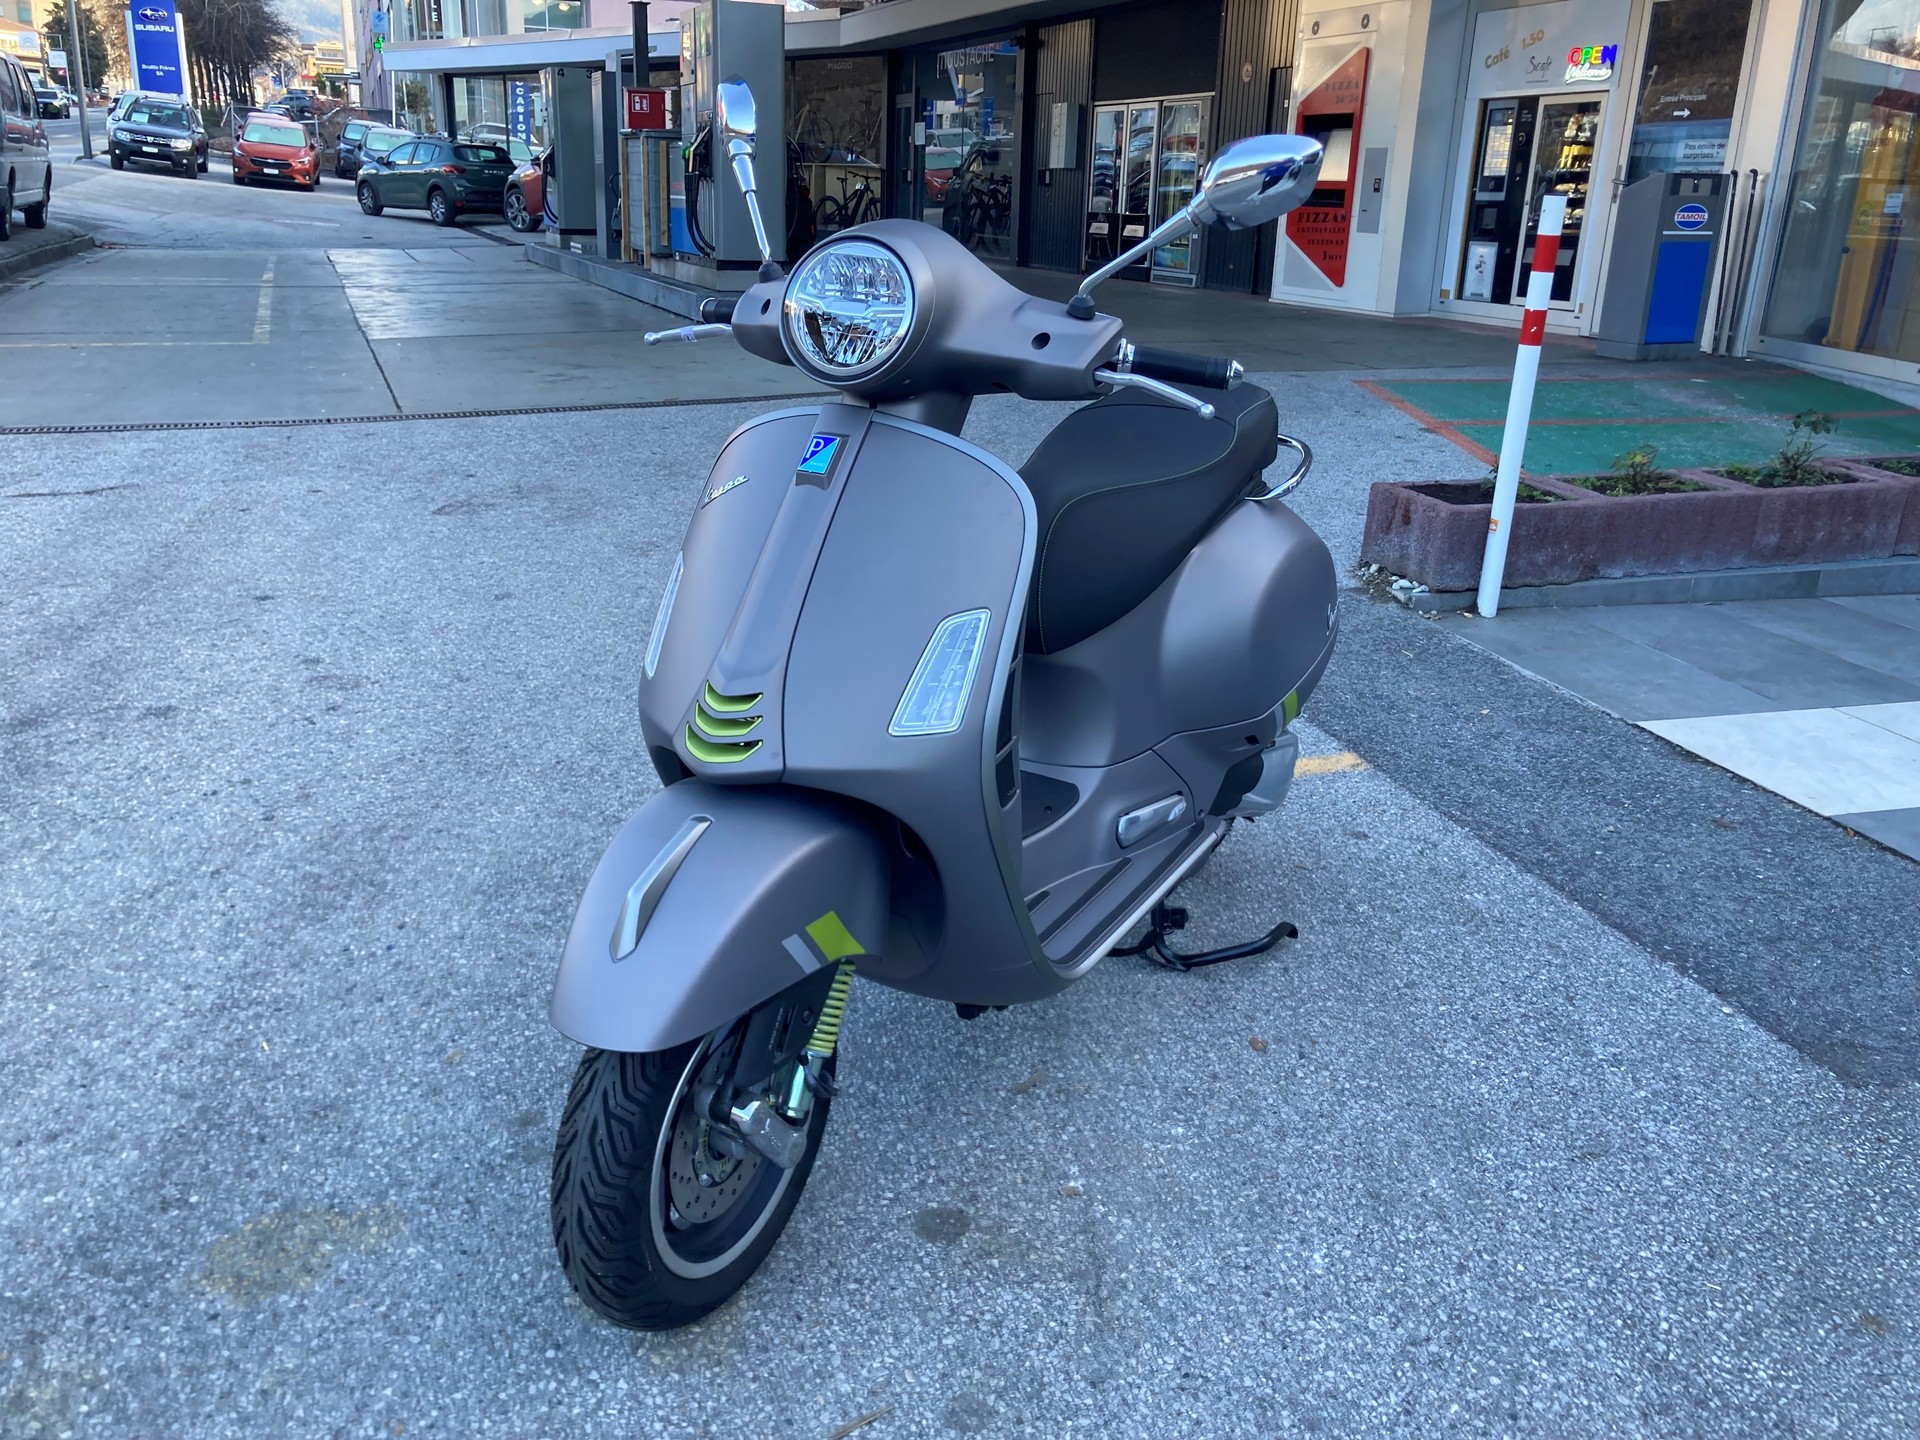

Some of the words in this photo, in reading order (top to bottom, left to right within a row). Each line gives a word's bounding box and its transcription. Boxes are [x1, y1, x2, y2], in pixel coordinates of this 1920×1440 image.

[135, 24, 174, 32] SUBARU
[1484, 45, 1510, 69] Café
[1521, 29, 1545, 50] 1.50
[1567, 44, 1618, 66] OPEN
[557, 68, 565, 77] 4
[586, 70, 593, 79] 3
[1564, 62, 1612, 85] Welcome
[1716, 142, 1726, 150] de
[1682, 151, 1714, 160] surprises
[1297, 211, 1347, 223] PIZZAS
[1675, 213, 1706, 221] TAMOIL
[805, 439, 825, 459] P
